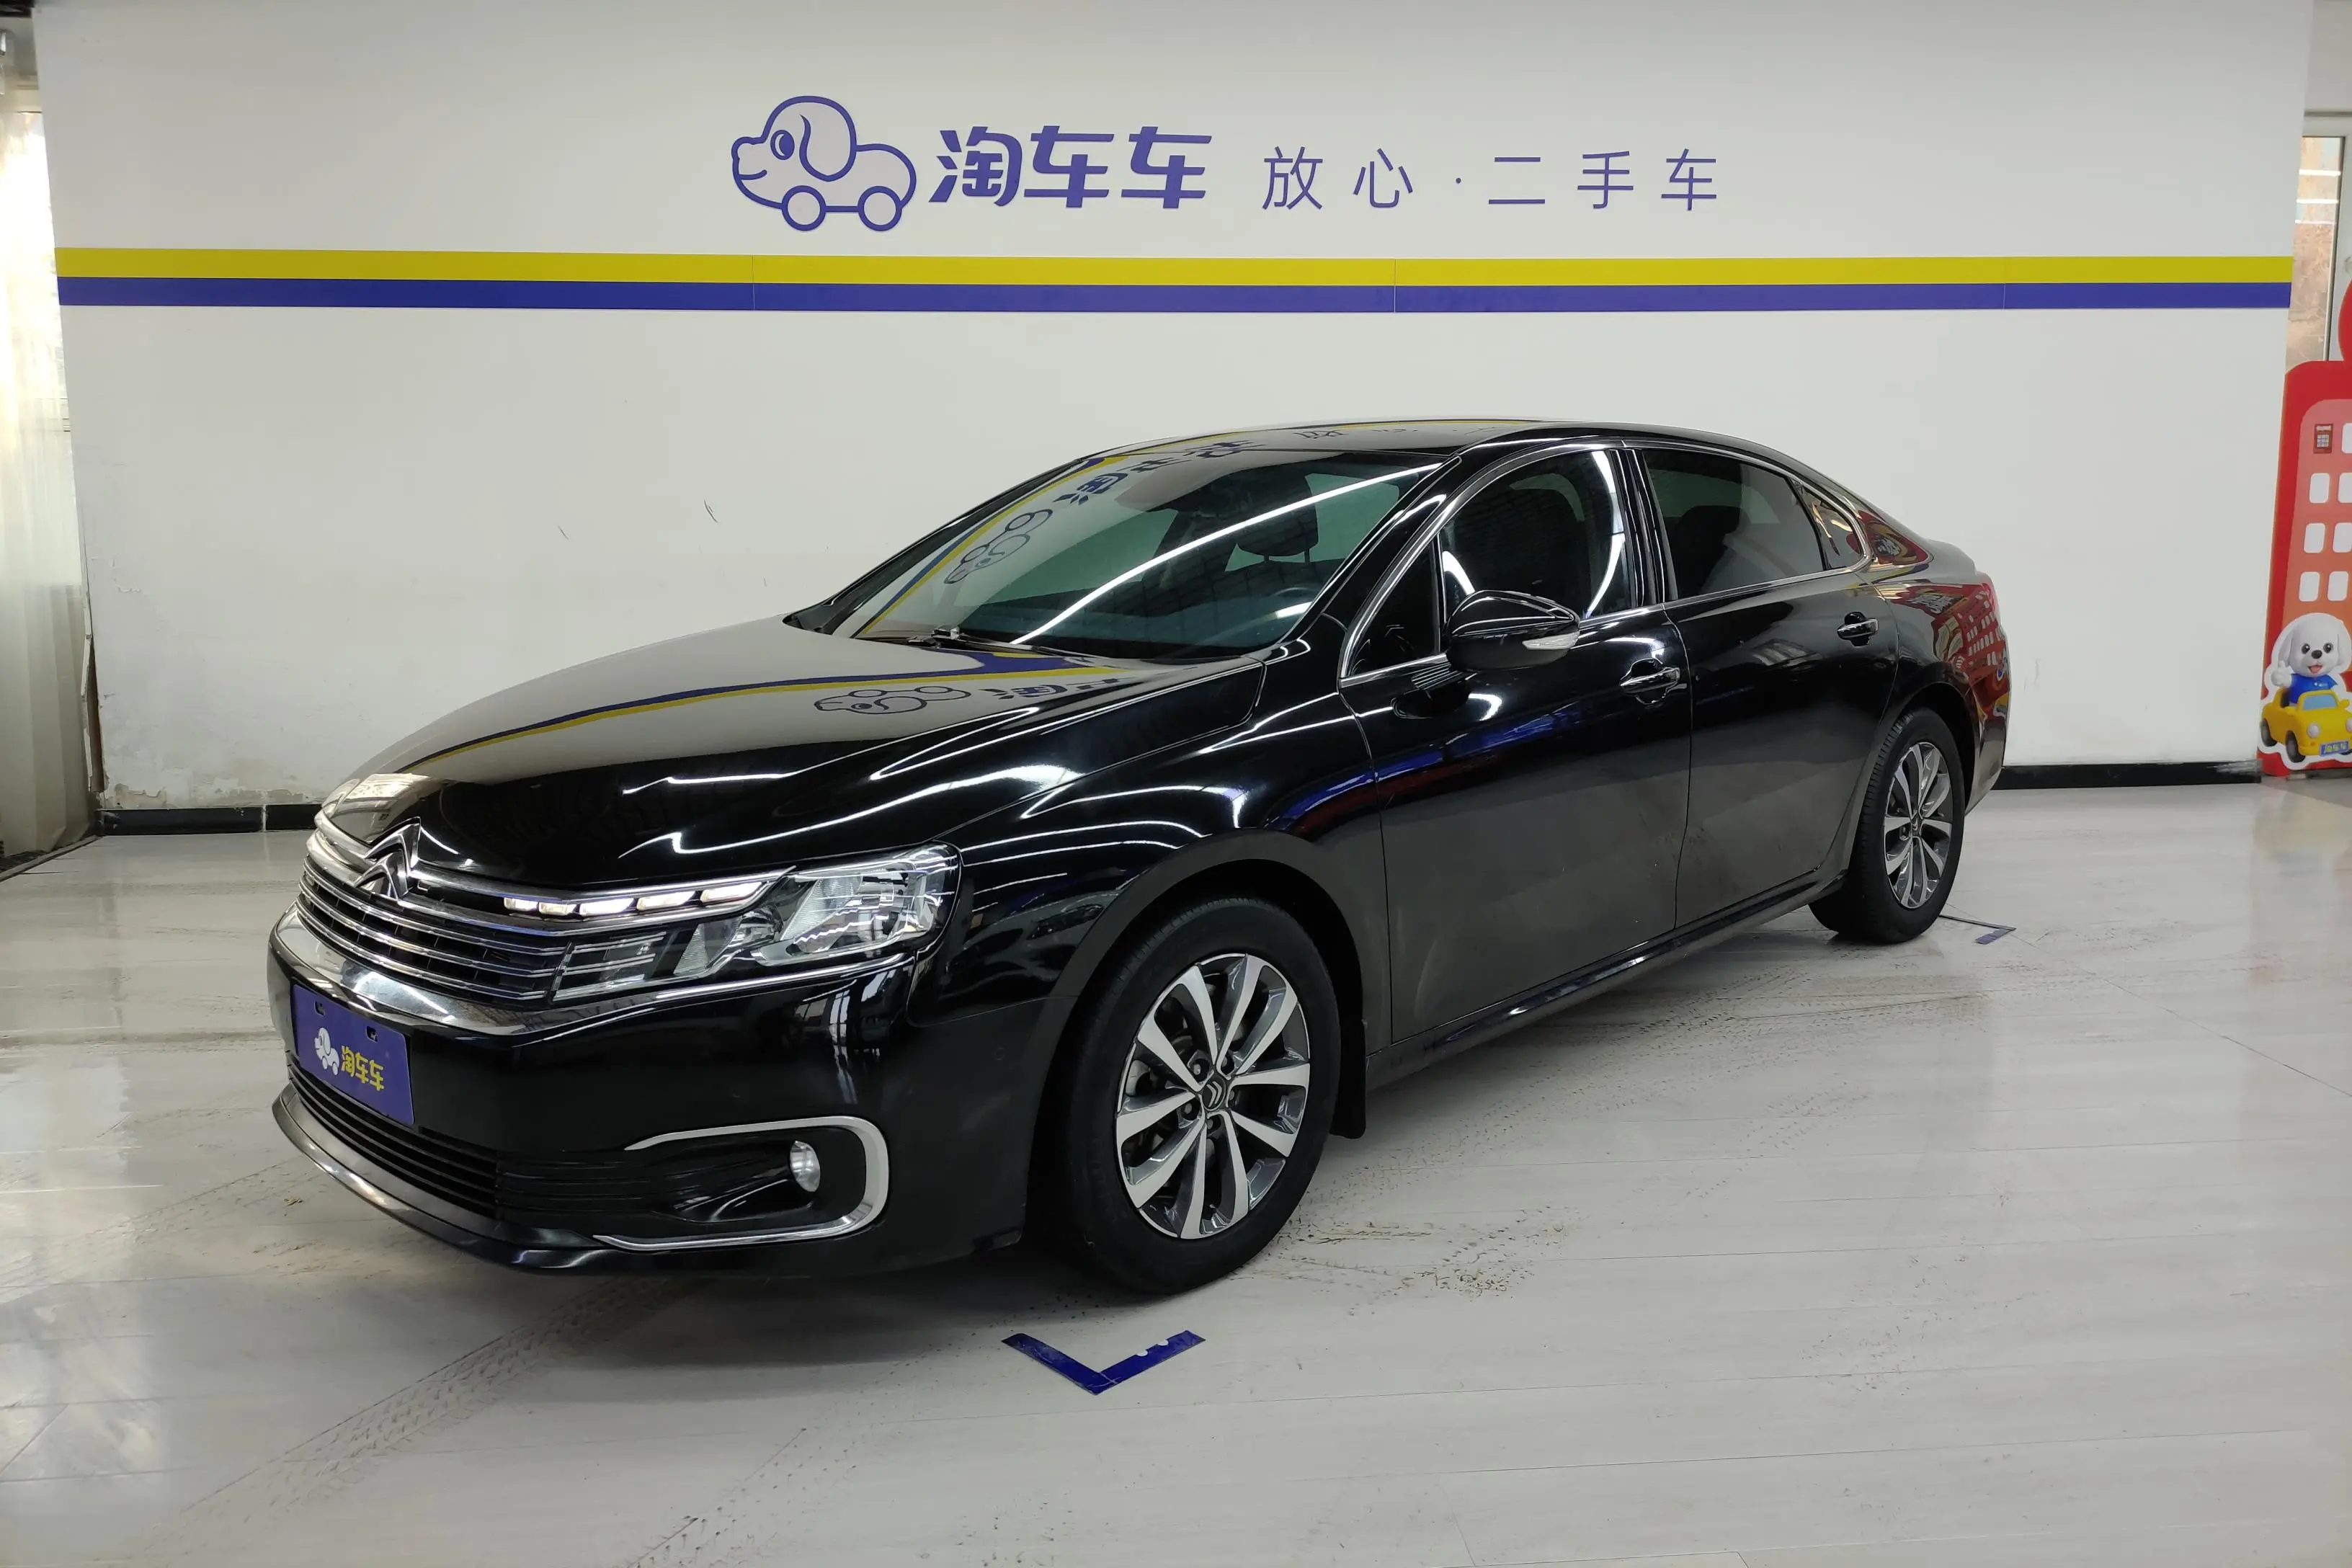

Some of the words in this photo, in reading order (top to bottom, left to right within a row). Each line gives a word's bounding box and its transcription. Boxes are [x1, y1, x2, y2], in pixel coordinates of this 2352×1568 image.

[929, 125, 1212, 209] 淘车车
[341, 1046, 385, 1091] 淘车车
